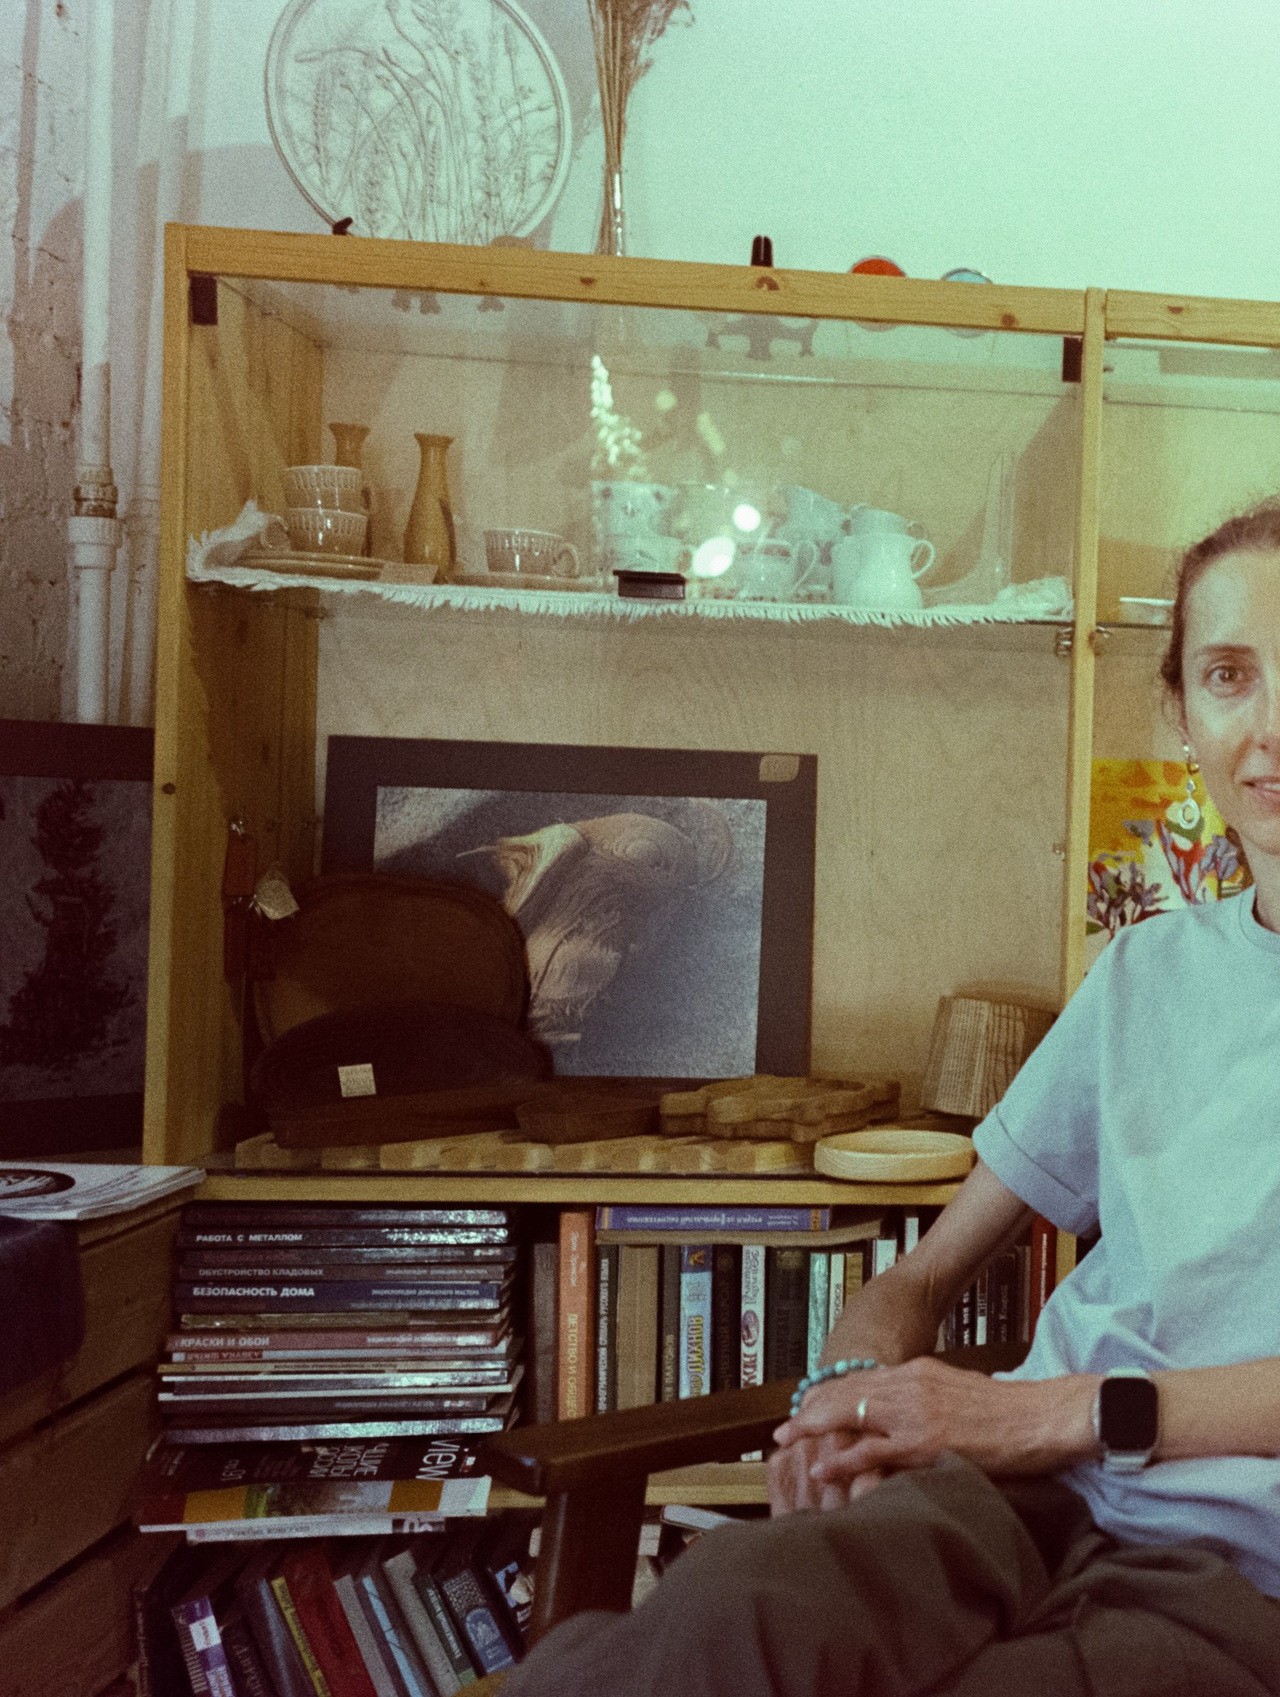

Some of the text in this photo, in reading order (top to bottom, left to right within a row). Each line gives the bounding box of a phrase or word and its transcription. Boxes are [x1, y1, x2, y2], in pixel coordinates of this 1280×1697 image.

[196, 1233, 303, 1243] РАБОТА С МЕТАЛЛОМ
[198, 1266, 324, 1277] ОБУСТРОЙСТВО КЛАДОВЫХ
[192, 1286, 315, 1297] БЕЗОПАСНОСТЬ ДОМА
[180, 1335, 224, 1347] КРАСКИ
[227, 1335, 236, 1346] И
[564, 1376, 578, 1418] ОБЩЕС
[328, 1445, 366, 1477] КОЛЫ
[354, 1442, 390, 1476] ЧШИЕ
